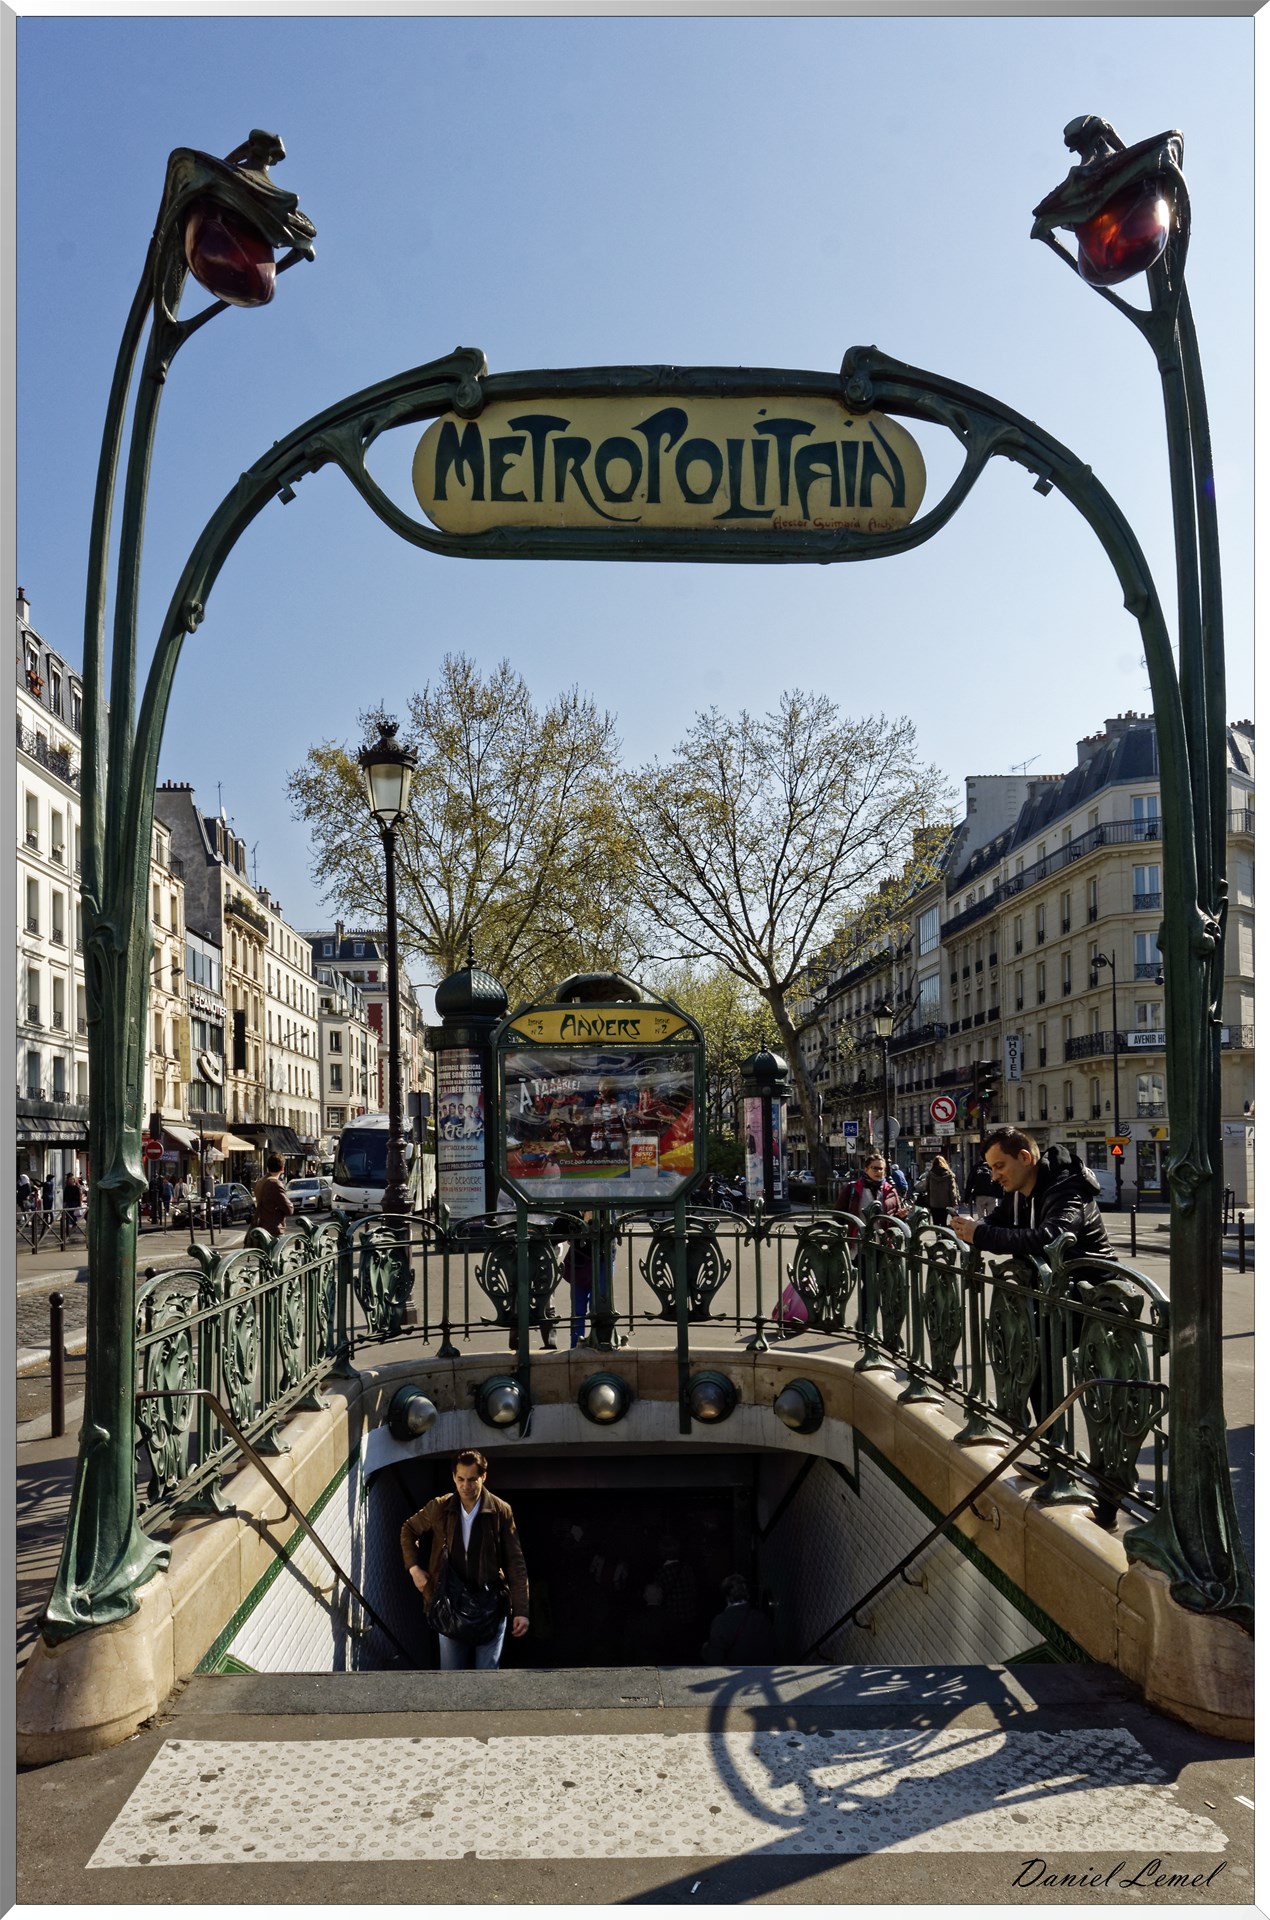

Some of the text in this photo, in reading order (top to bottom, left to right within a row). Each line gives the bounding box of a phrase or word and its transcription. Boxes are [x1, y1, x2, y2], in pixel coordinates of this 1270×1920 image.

[433, 406, 906, 521] METROPOLITAIN
[560, 1014, 641, 1040] ANVERS
[1133, 1034, 1157, 1045] AVENIR
